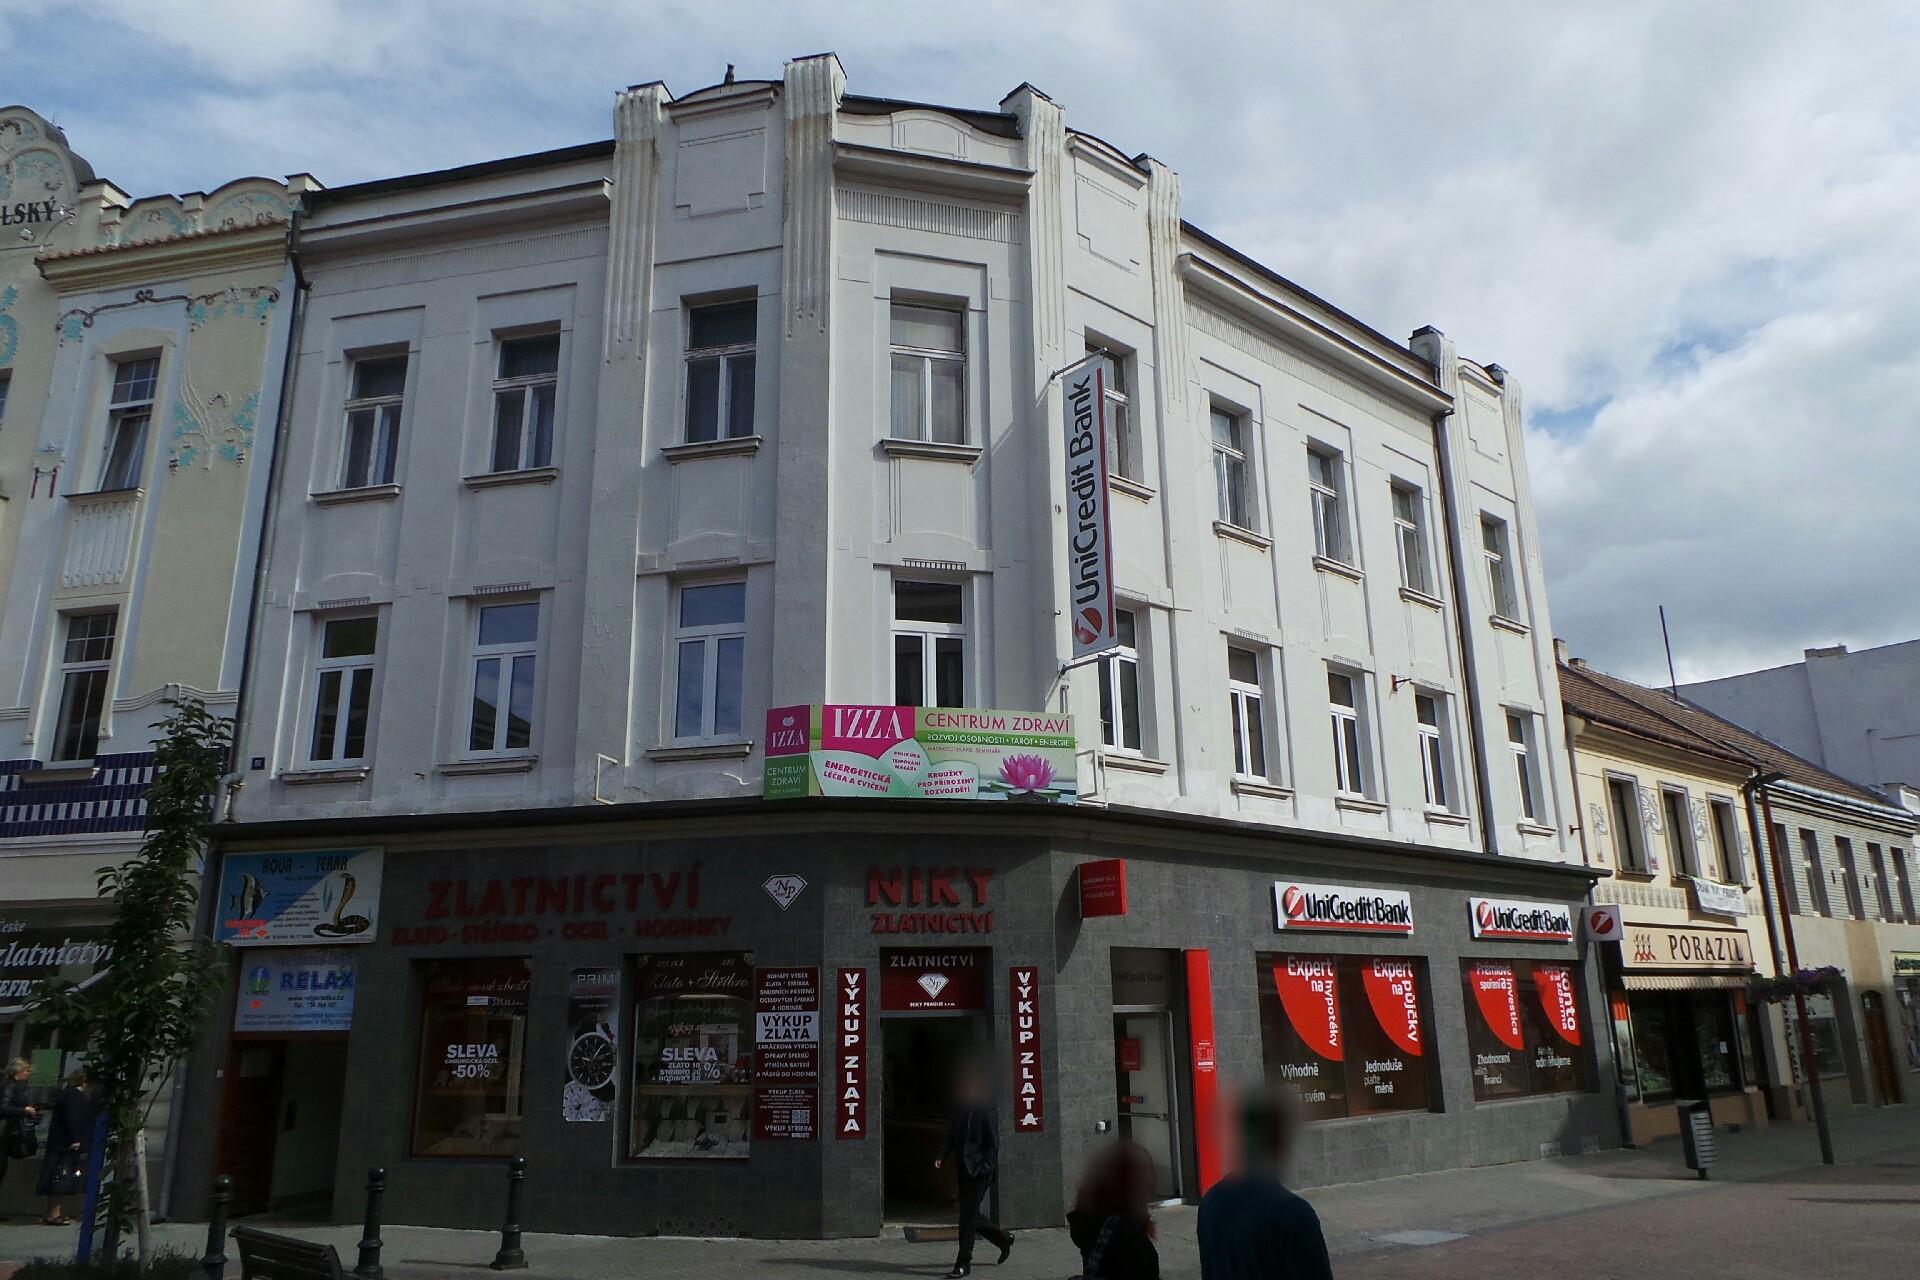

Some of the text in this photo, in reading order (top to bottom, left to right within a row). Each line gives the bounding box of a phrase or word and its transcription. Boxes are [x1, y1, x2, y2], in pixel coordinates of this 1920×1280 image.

[1068, 374, 1100, 605] UniCredit Bank
[832, 707, 905, 739] IZZA
[925, 713, 1070, 734] CENTRUM ZDRAVÍ
[772, 729, 805, 748] IZZA
[928, 733, 1070, 747] ROZVOJ OSOBNOSTI TAROT ENERGIE
[767, 765, 806, 776] CENTRUM
[825, 760, 892, 784] ENERGETICKÁ
[927, 770, 963, 779] KROUŽKY
[823, 770, 848, 782] LÉČBA
[857, 779, 889, 793] CVIČENÍ
[924, 788, 954, 796] ROZVOJ
[424, 863, 703, 919] ZLATNICTVÍ
[867, 865, 993, 905] NIKY
[1306, 892, 1411, 923] UniCredit Bank
[871, 911, 993, 933] ZLATNICTVÍ
[1493, 906, 1571, 932] UniCredit Bank
[390, 926, 448, 945] ZLATO
[562, 921, 609, 940] OCEL
[635, 916, 733, 937] HODINKY
[1667, 934, 1744, 961] PORAZIL
[889, 953, 974, 968] ZLATNICTVÍ
[1287, 956, 1334, 981] Expert
[1373, 958, 1414, 982] Expert
[280, 969, 354, 991] RELAX
[576, 974, 616, 985] PRIM
[1311, 979, 1323, 992] na
[1391, 983, 1403, 995] na
[1560, 967, 1576, 1031] konto
[762, 1014, 812, 1027] VÝKUP
[1325, 980, 1338, 1047] hypotéky
[1402, 980, 1418, 1042] půjčky
[764, 1028, 810, 1039] ZLATA
[446, 1043, 499, 1059] SLEVA
[661, 1047, 718, 1062] SLEVA
[843, 972, 861, 1132] VÝKUP ZLATA
[1017, 971, 1038, 1126] VÝKUP ZLATA
[1476, 1051, 1511, 1065] Zhodnocení
[451, 1064, 490, 1079] -50%
[1280, 1062, 1319, 1080] Výhodně
[1365, 1058, 1403, 1073] Jednoduše
[1304, 1091, 1326, 1103] svém
[1375, 1081, 1394, 1094] méně
